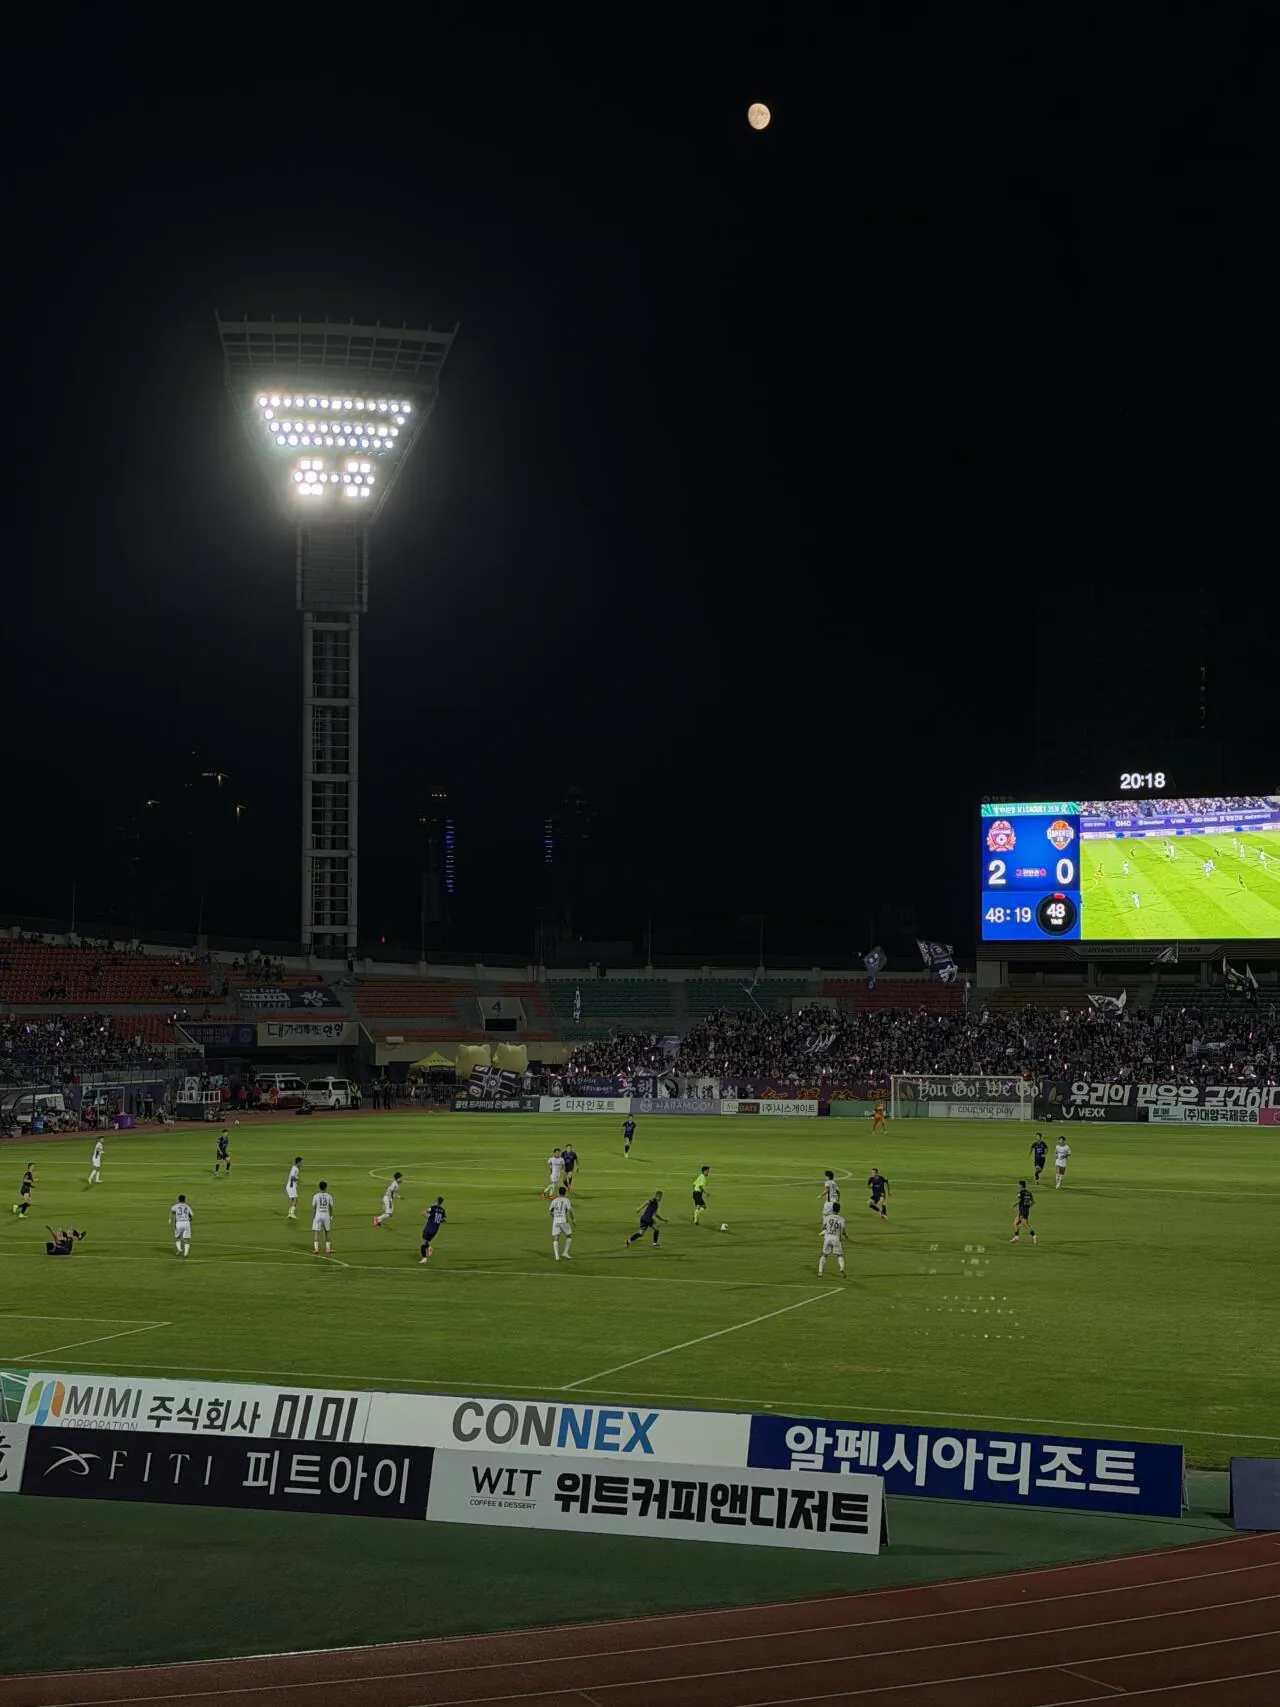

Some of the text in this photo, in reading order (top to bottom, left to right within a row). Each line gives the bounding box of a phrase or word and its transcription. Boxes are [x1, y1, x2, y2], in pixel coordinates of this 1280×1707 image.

[1120, 772, 1166, 790] 20:18
[988, 859, 1006, 884] 2
[1056, 858, 1074, 884] 0
[1046, 903, 1066, 918] 48
[492, 1001, 502, 1012] 4
[917, 1079, 948, 1101] You
[1070, 1081, 1132, 1106] 우리의
[565, 1101, 616, 1112] 디자인포트
[762, 1103, 817, 1113] (주)시스게이트
[996, 1104, 1015, 1116] play
[1078, 1107, 1106, 1118] VEXX
[1183, 1107, 1258, 1123] (주)대양국제운송
[318, 1196, 327, 1207] 13
[177, 1206, 188, 1216] 34
[828, 1218, 839, 1229] 96
[65, 1385, 143, 1419] MIMI
[60, 1417, 139, 1431] CORPORATION
[146, 1394, 359, 1442] 주식회사 미미
[452, 1401, 660, 1455] CONNEX
[108, 1450, 213, 1486] FITI
[785, 1425, 1141, 1496] 알펜시아리조트
[242, 1450, 410, 1505] 피트아이
[471, 1466, 542, 1498] WIT
[469, 1498, 497, 1508] COFFEE
[503, 1500, 537, 1511] DESSERT
[554, 1472, 869, 1535] 위트커피앤디저트
